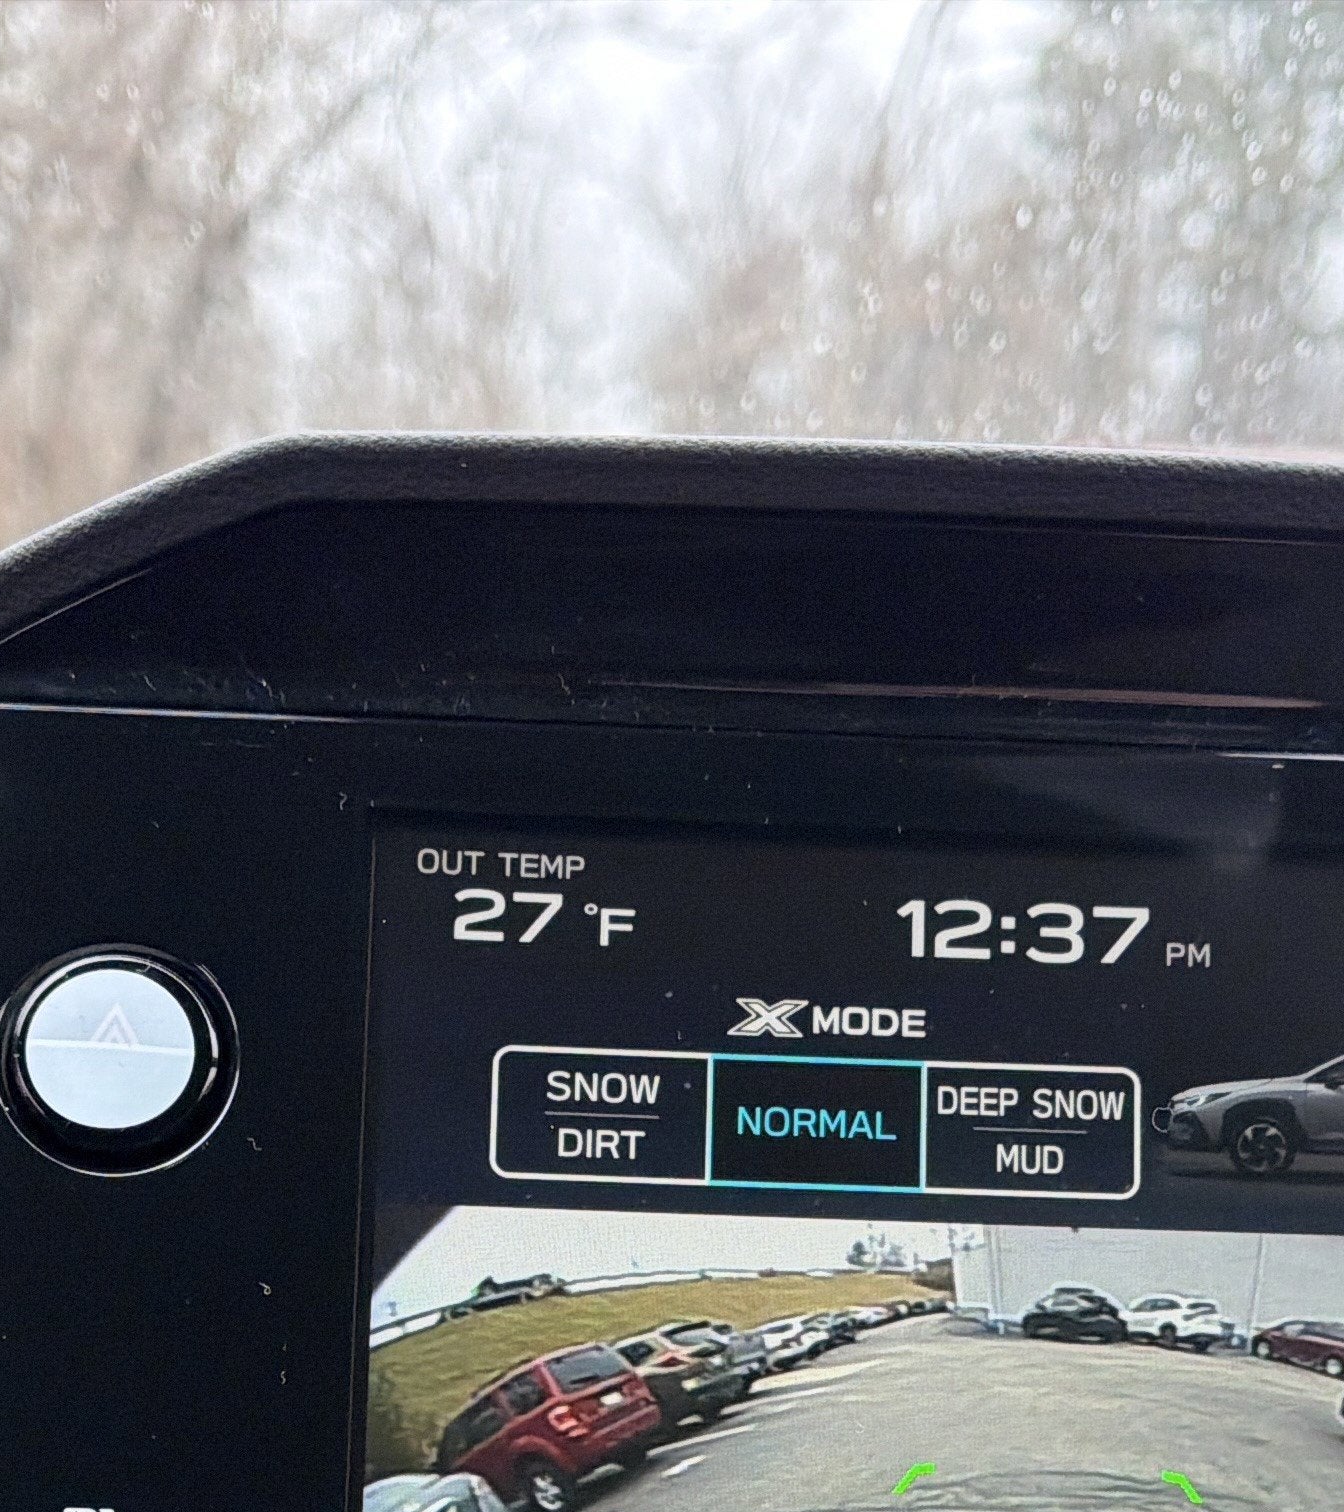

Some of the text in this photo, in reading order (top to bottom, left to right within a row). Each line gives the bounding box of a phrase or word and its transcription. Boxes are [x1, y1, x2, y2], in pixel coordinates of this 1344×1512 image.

[417, 847, 586, 880] OUT TEMP
[452, 888, 565, 944] 27
[895, 898, 1212, 969] 12:37 PM
[811, 1004, 927, 1038] MODE
[545, 1070, 661, 1105] SNOW
[936, 1085, 1126, 1123] DEEP SNOW
[736, 1106, 897, 1143] NORMAL
[556, 1129, 646, 1162] DIRT
[995, 1143, 1065, 1176] MUD
